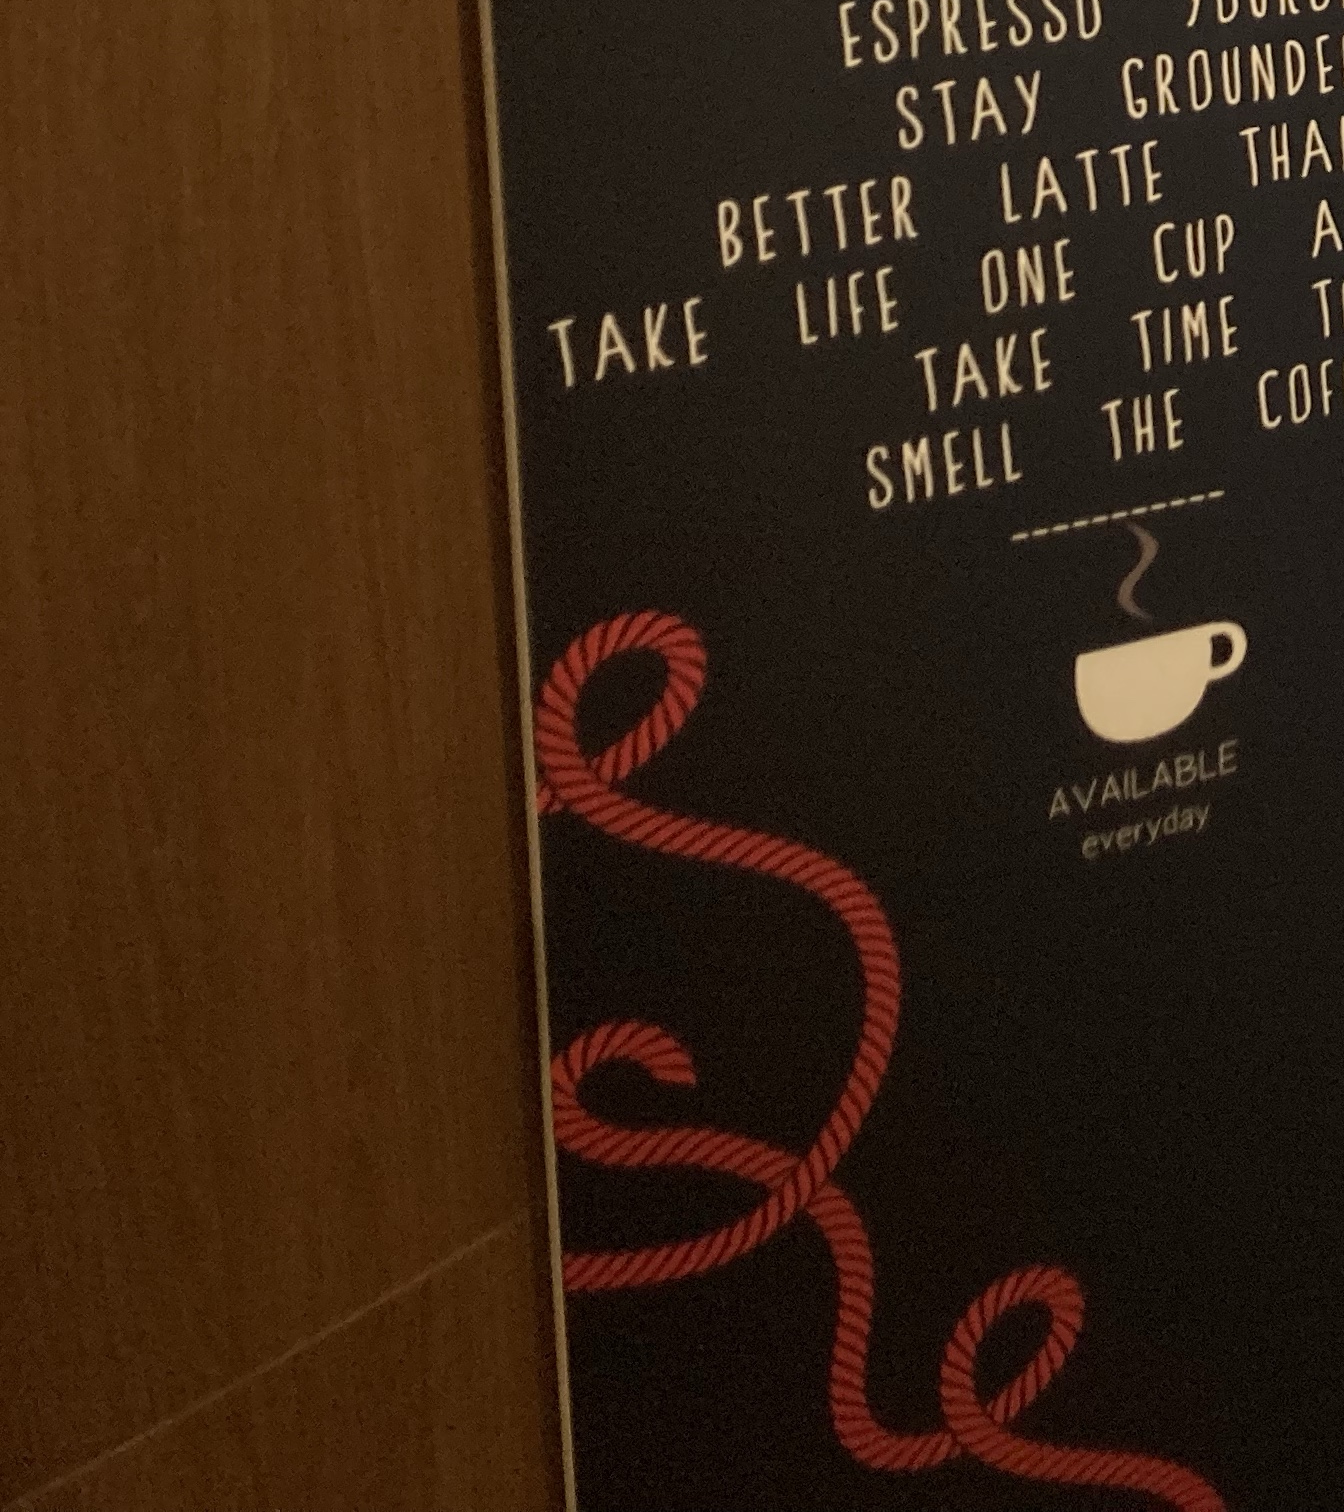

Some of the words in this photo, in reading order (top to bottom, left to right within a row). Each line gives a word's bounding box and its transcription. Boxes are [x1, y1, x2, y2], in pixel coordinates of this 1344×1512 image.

[895, 69, 1042, 151] STAY
[716, 174, 919, 269] BETTER
[1000, 139, 1164, 225] LATTE
[547, 296, 709, 388] TAKE
[795, 265, 900, 346] LIFE
[980, 237, 1076, 315] ONE
[1152, 212, 1236, 285] CUP
[913, 327, 1053, 413] TAKE
[1130, 294, 1239, 372] TIME
[865, 422, 1023, 510] SMELL
[1100, 387, 1185, 462] THE
[1048, 738, 1238, 820] AVAILABLE
[1081, 805, 1210, 859] everyday
